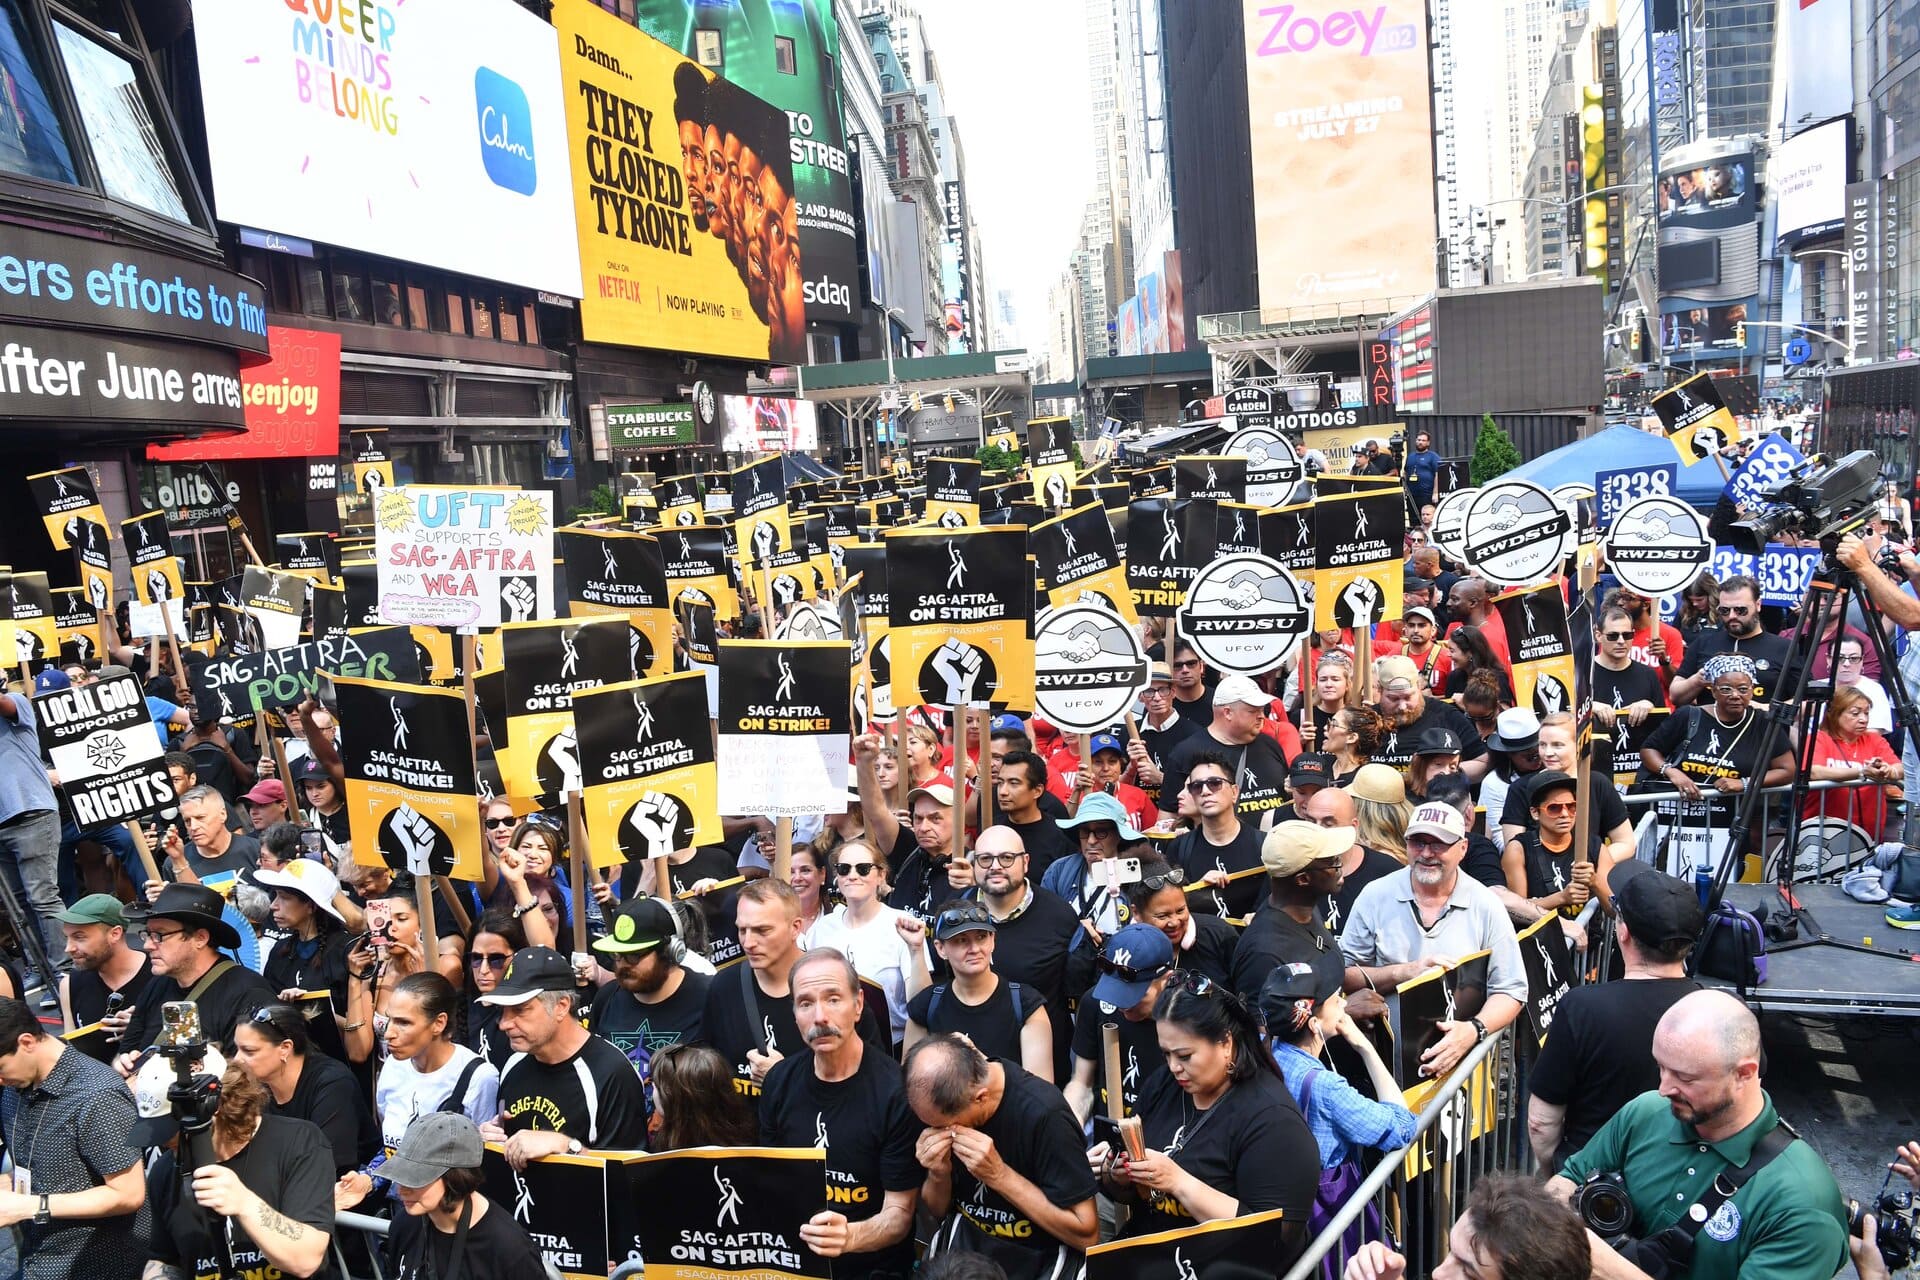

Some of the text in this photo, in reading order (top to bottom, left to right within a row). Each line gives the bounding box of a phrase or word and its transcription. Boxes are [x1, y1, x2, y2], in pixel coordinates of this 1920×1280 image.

[1256, 4, 1386, 57] Zoey
[574, 33, 633, 80] Damn...
[295, 58, 399, 136] BELONG
[579, 80, 654, 155] THEY
[1274, 96, 1404, 127] STREAMING
[482, 106, 533, 161] Calm
[1296, 116, 1380, 140] JULY 27
[586, 136, 684, 210] CLONED
[805, 204, 828, 219] AND
[949, 181, 961, 230] Locker
[590, 185, 693, 257] TYRONE
[1854, 197, 1869, 347] TIMES SQUARE
[86, 261, 204, 321] efforts
[207, 284, 233, 328] to
[598, 273, 642, 305] NETFLIX
[666, 294, 689, 312] NOW
[690, 298, 726, 319] PLAYING
[0, 342, 86, 397] fter
[98, 352, 185, 403] June
[1371, 344, 1390, 405] BAR
[1234, 389, 1259, 401] BEER
[1228, 401, 1267, 413] GARDEN
[608, 411, 693, 425] STARBUCKS
[1273, 410, 1357, 430] HOTDOGS
[633, 426, 677, 438] COFFEE
[310, 464, 336, 477] NOW
[309, 477, 336, 490] OPEN
[382, 501, 404, 513] UNION
[1601, 476, 1612, 521] LOCAL
[382, 509, 408, 525] STRONG
[417, 491, 505, 529] UFT
[512, 506, 535, 516] UNION
[414, 529, 503, 546] SUPPORTS
[1476, 521, 1560, 560] RWDSU
[1329, 548, 1392, 565] ON STRIKE!
[1505, 552, 1540, 567] UFCW
[1614, 549, 1701, 559] RWDSU
[665, 567, 715, 577] ON STRIKE!
[1056, 558, 1108, 584] ON STRIKE!
[391, 573, 479, 597] AND WGA
[1160, 580, 1177, 589] ON
[250, 600, 294, 613] ON STRIKE!
[582, 589, 653, 604] ON STRIKE!
[909, 603, 1005, 622] ON STRIKE!
[1194, 617, 1297, 631] RWDSU
[1225, 644, 1265, 652] UFCW
[1519, 642, 1563, 659] ON STRIKE!
[37, 686, 98, 728] LOCAL
[526, 697, 553, 711] ON
[1064, 699, 1104, 708] UFCW
[54, 708, 139, 738] SUPPORTS
[738, 718, 831, 731] ON STRIKE!
[602, 749, 694, 779] ON STRIKE!
[1681, 761, 1739, 780] STRONG
[362, 763, 453, 789] ON STRIKE!
[71, 771, 175, 826] RIGHTS
[1416, 808, 1449, 825] FDNY
[670, 1245, 801, 1270] ON STRIKE!
